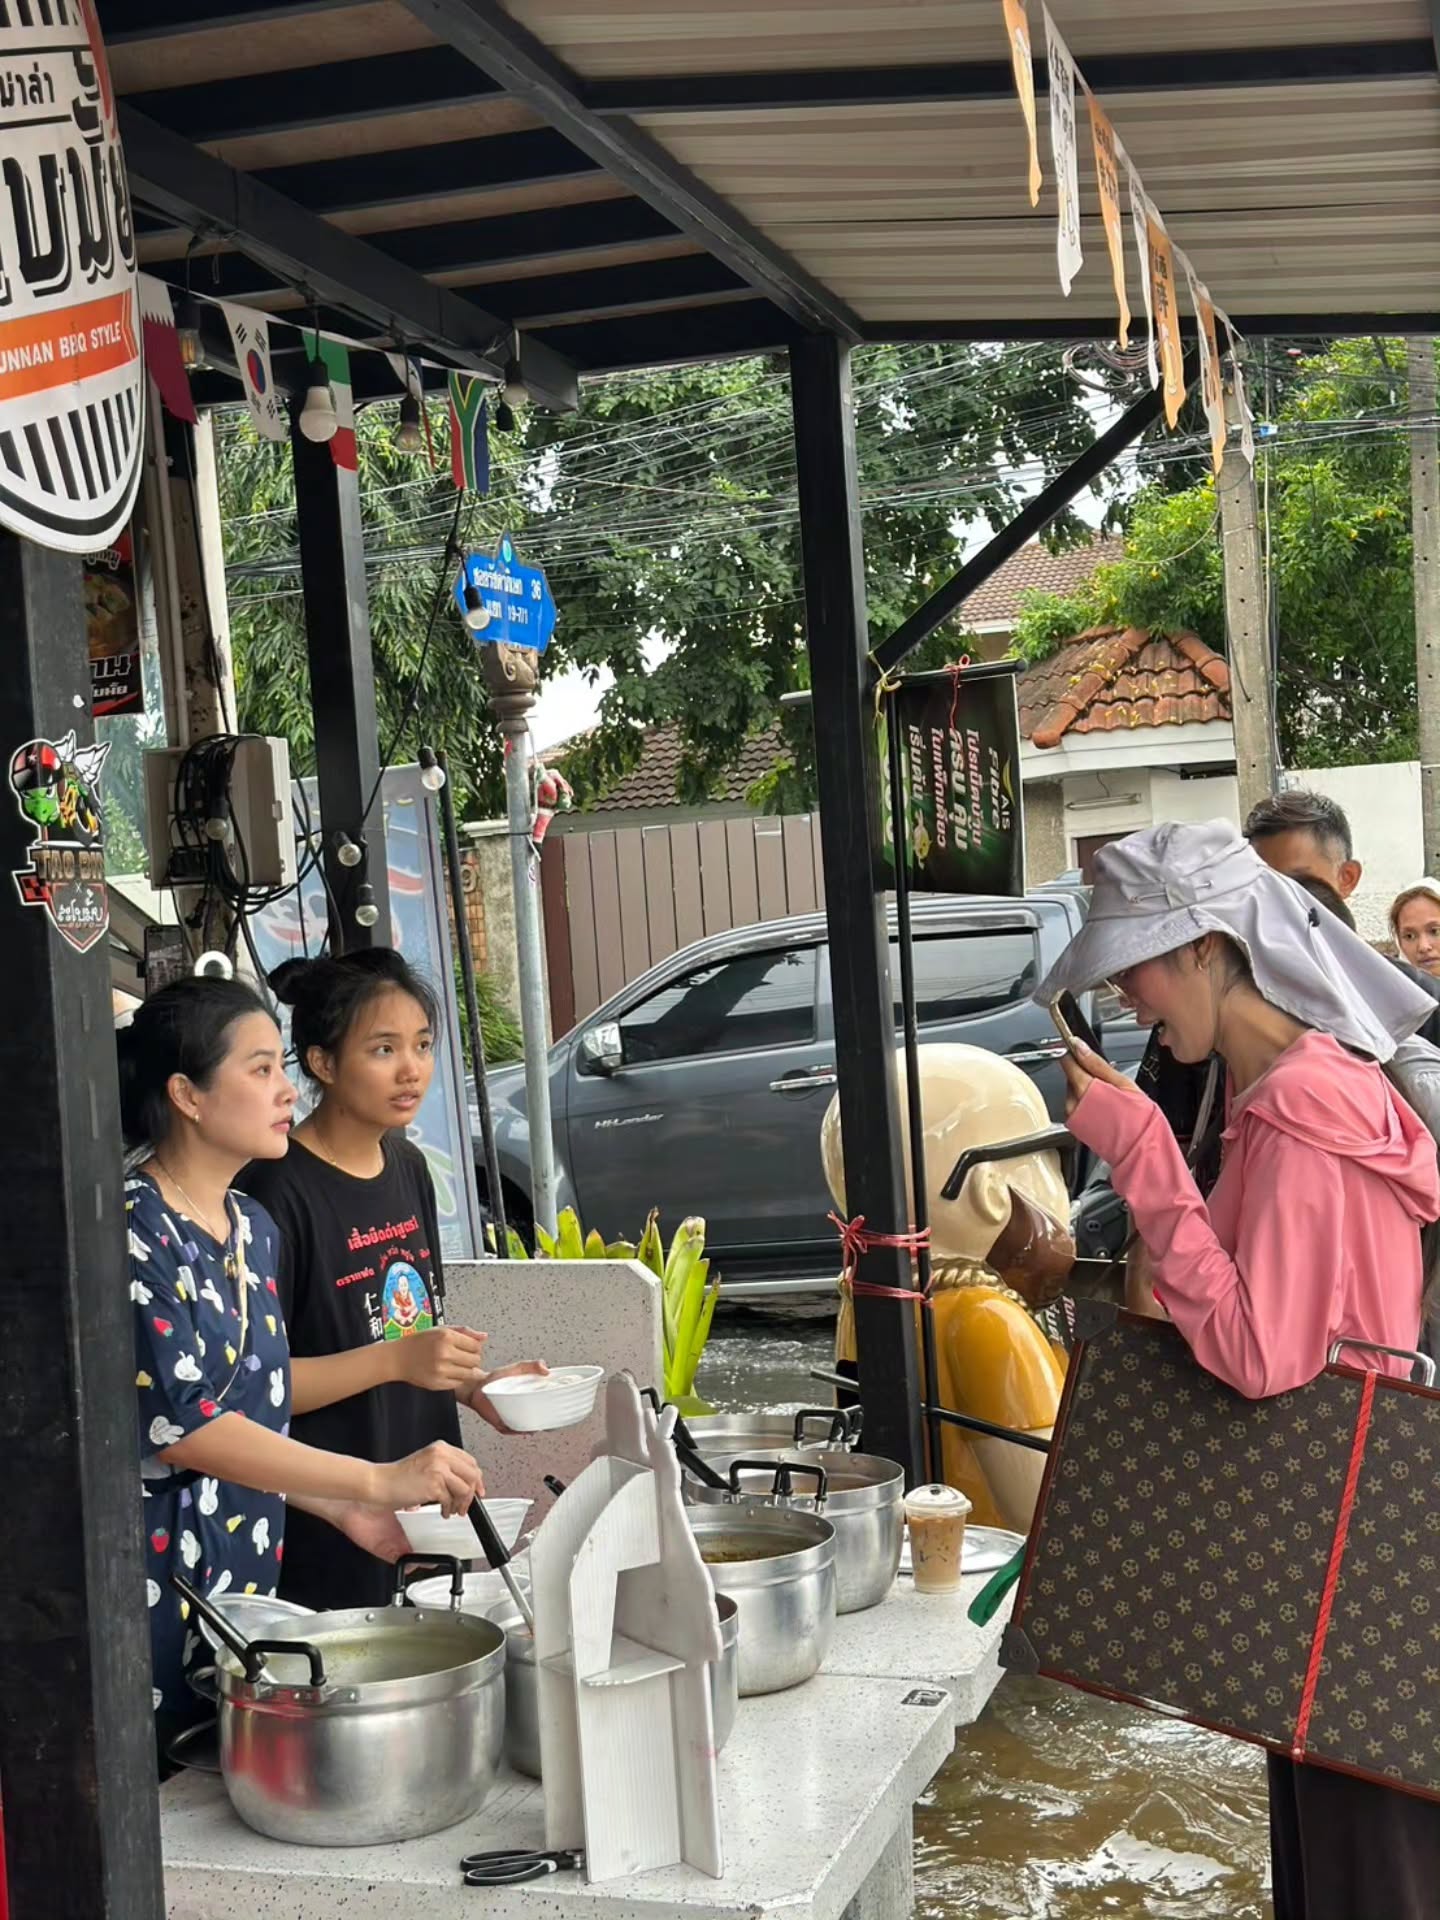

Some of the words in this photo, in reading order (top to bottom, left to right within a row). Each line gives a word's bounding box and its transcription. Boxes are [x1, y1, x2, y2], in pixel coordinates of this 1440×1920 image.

[59, 332, 87, 358] BBQ
[90, 321, 121, 349] STYLE
[909, 725, 926, 801] เริ่มต้น
[949, 727, 966, 794] ครบ
[988, 746, 1000, 830] Fibre
[949, 802, 972, 850] คุ้ม
[1001, 794, 1010, 830] AIS
